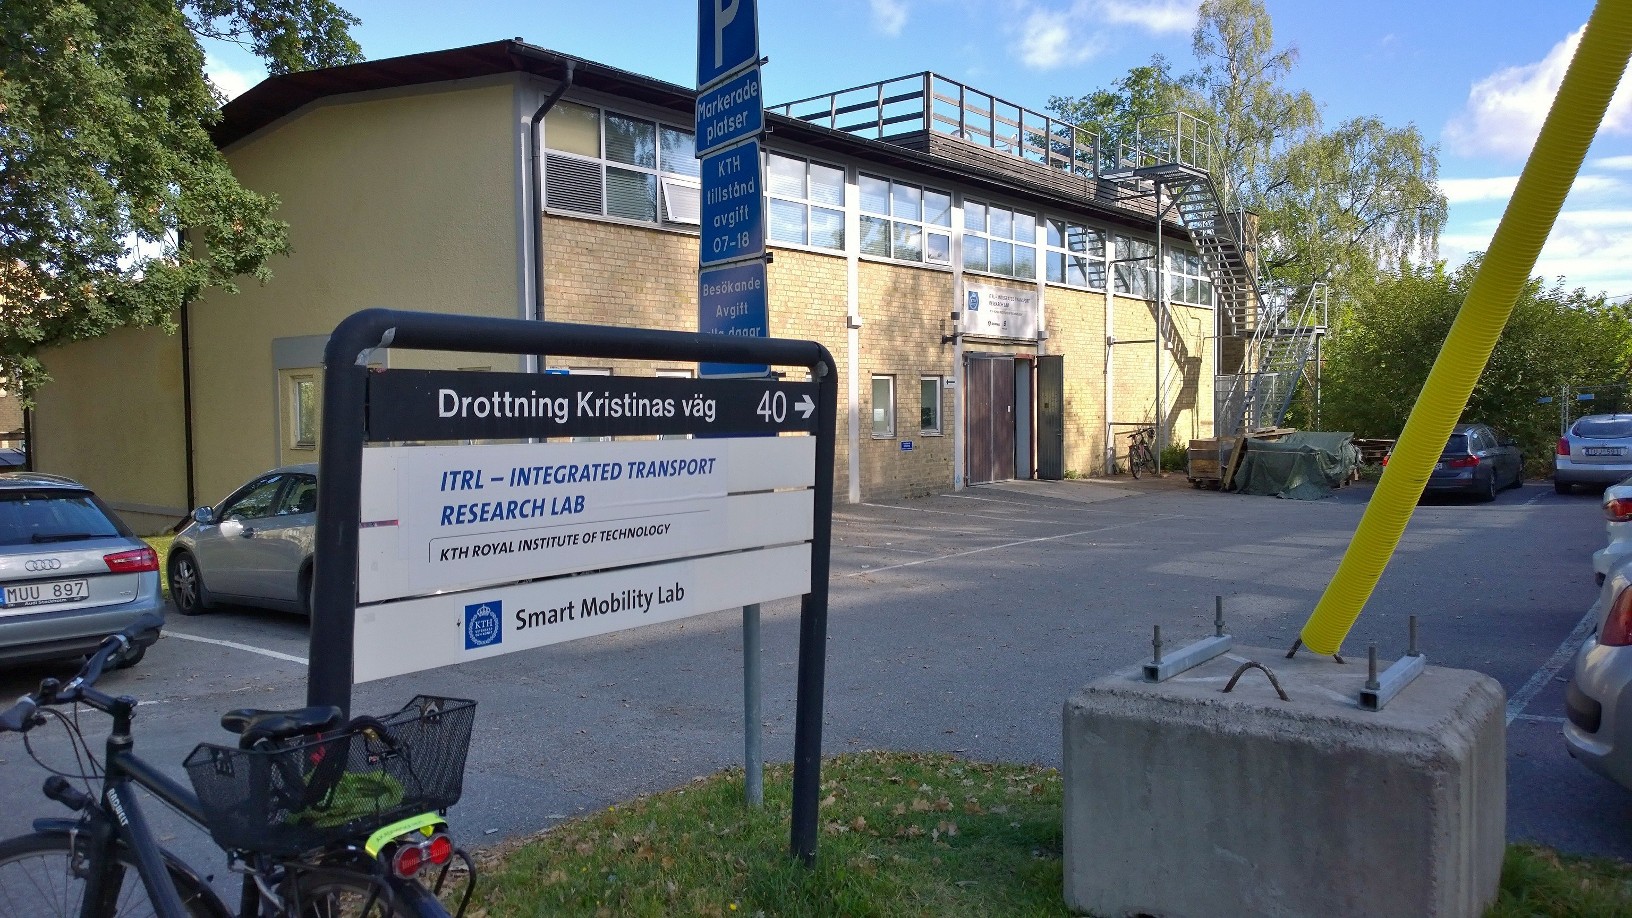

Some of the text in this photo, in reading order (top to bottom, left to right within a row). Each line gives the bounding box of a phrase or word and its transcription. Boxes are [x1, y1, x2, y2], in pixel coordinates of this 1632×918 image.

[714, 0, 740, 70] P
[698, 80, 758, 123] Markerade
[707, 110, 749, 145] platser
[718, 155, 741, 177] KTH
[707, 176, 755, 205] tillstånd
[713, 204, 749, 228] avgift
[713, 231, 750, 253] 07-18
[703, 277, 761, 297] Besökande
[716, 302, 748, 319] Avgift
[438, 389, 787, 424] Drottning Kristinas väg 40
[440, 469, 484, 491] ITRL
[509, 462, 622, 487] INTEGRATED
[627, 458, 716, 479] TRANSPORT
[440, 495, 586, 526] RESEARCH LAB
[440, 523, 671, 561] KTH ROYAL INSTITUTE OF TECHNOLOGY
[6, 582, 83, 603] MUU 897
[515, 582, 685, 631] Smart Mobility Lab
[474, 618, 493, 629] KTH
